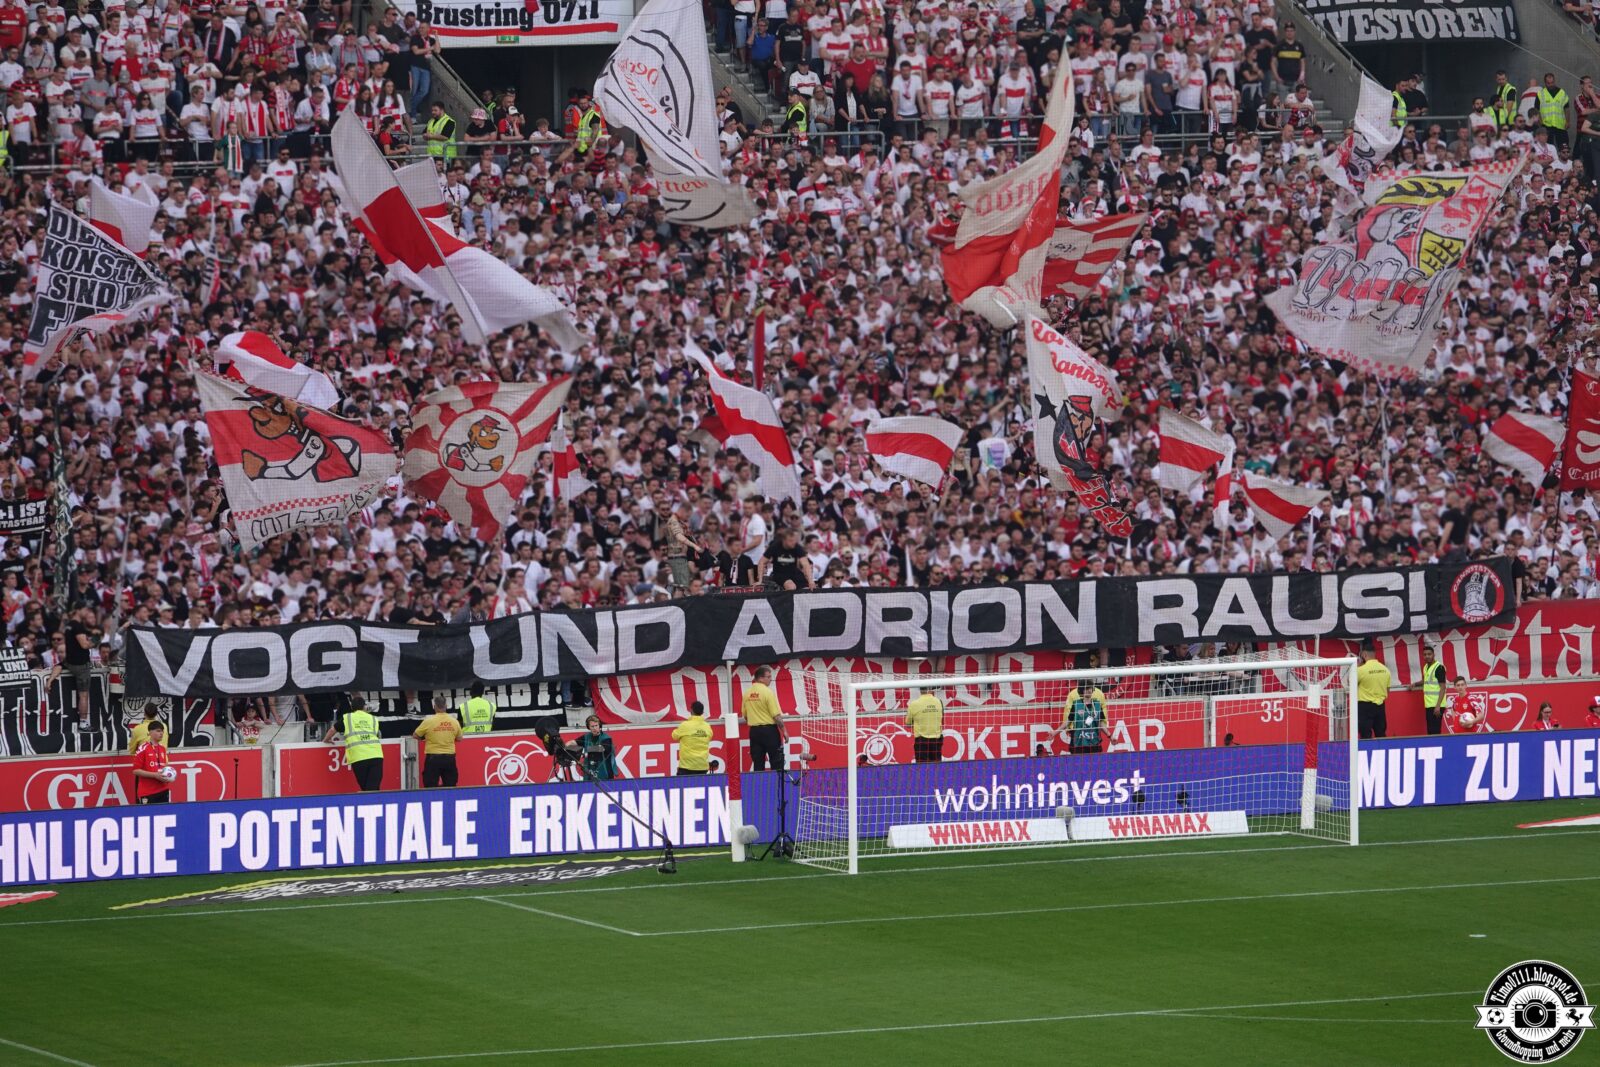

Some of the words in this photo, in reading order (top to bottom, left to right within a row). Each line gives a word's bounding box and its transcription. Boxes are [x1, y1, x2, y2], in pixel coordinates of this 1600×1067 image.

[416, 0, 536, 31] Brustring
[50, 273, 118, 312] SIND
[20, 500, 46, 518] IST
[133, 624, 420, 697] VOGT
[470, 605, 687, 680] UND
[722, 580, 1098, 660] ADRION
[1136, 570, 1429, 643] RAUS!
[3, 659, 28, 672] UND
[1260, 700, 1284, 723] 35
[328, 749, 351, 772] 34
[1358, 746, 1443, 807] MUT
[1465, 742, 1520, 802] ZU
[1544, 738, 1600, 798] NE
[934, 769, 1145, 814] wohninvest
[209, 798, 479, 872] POTENTIALE
[509, 785, 731, 855] ERKENNEN
[927, 820, 1032, 846] WINAMAX
[1107, 812, 1212, 838] WINAMAX
